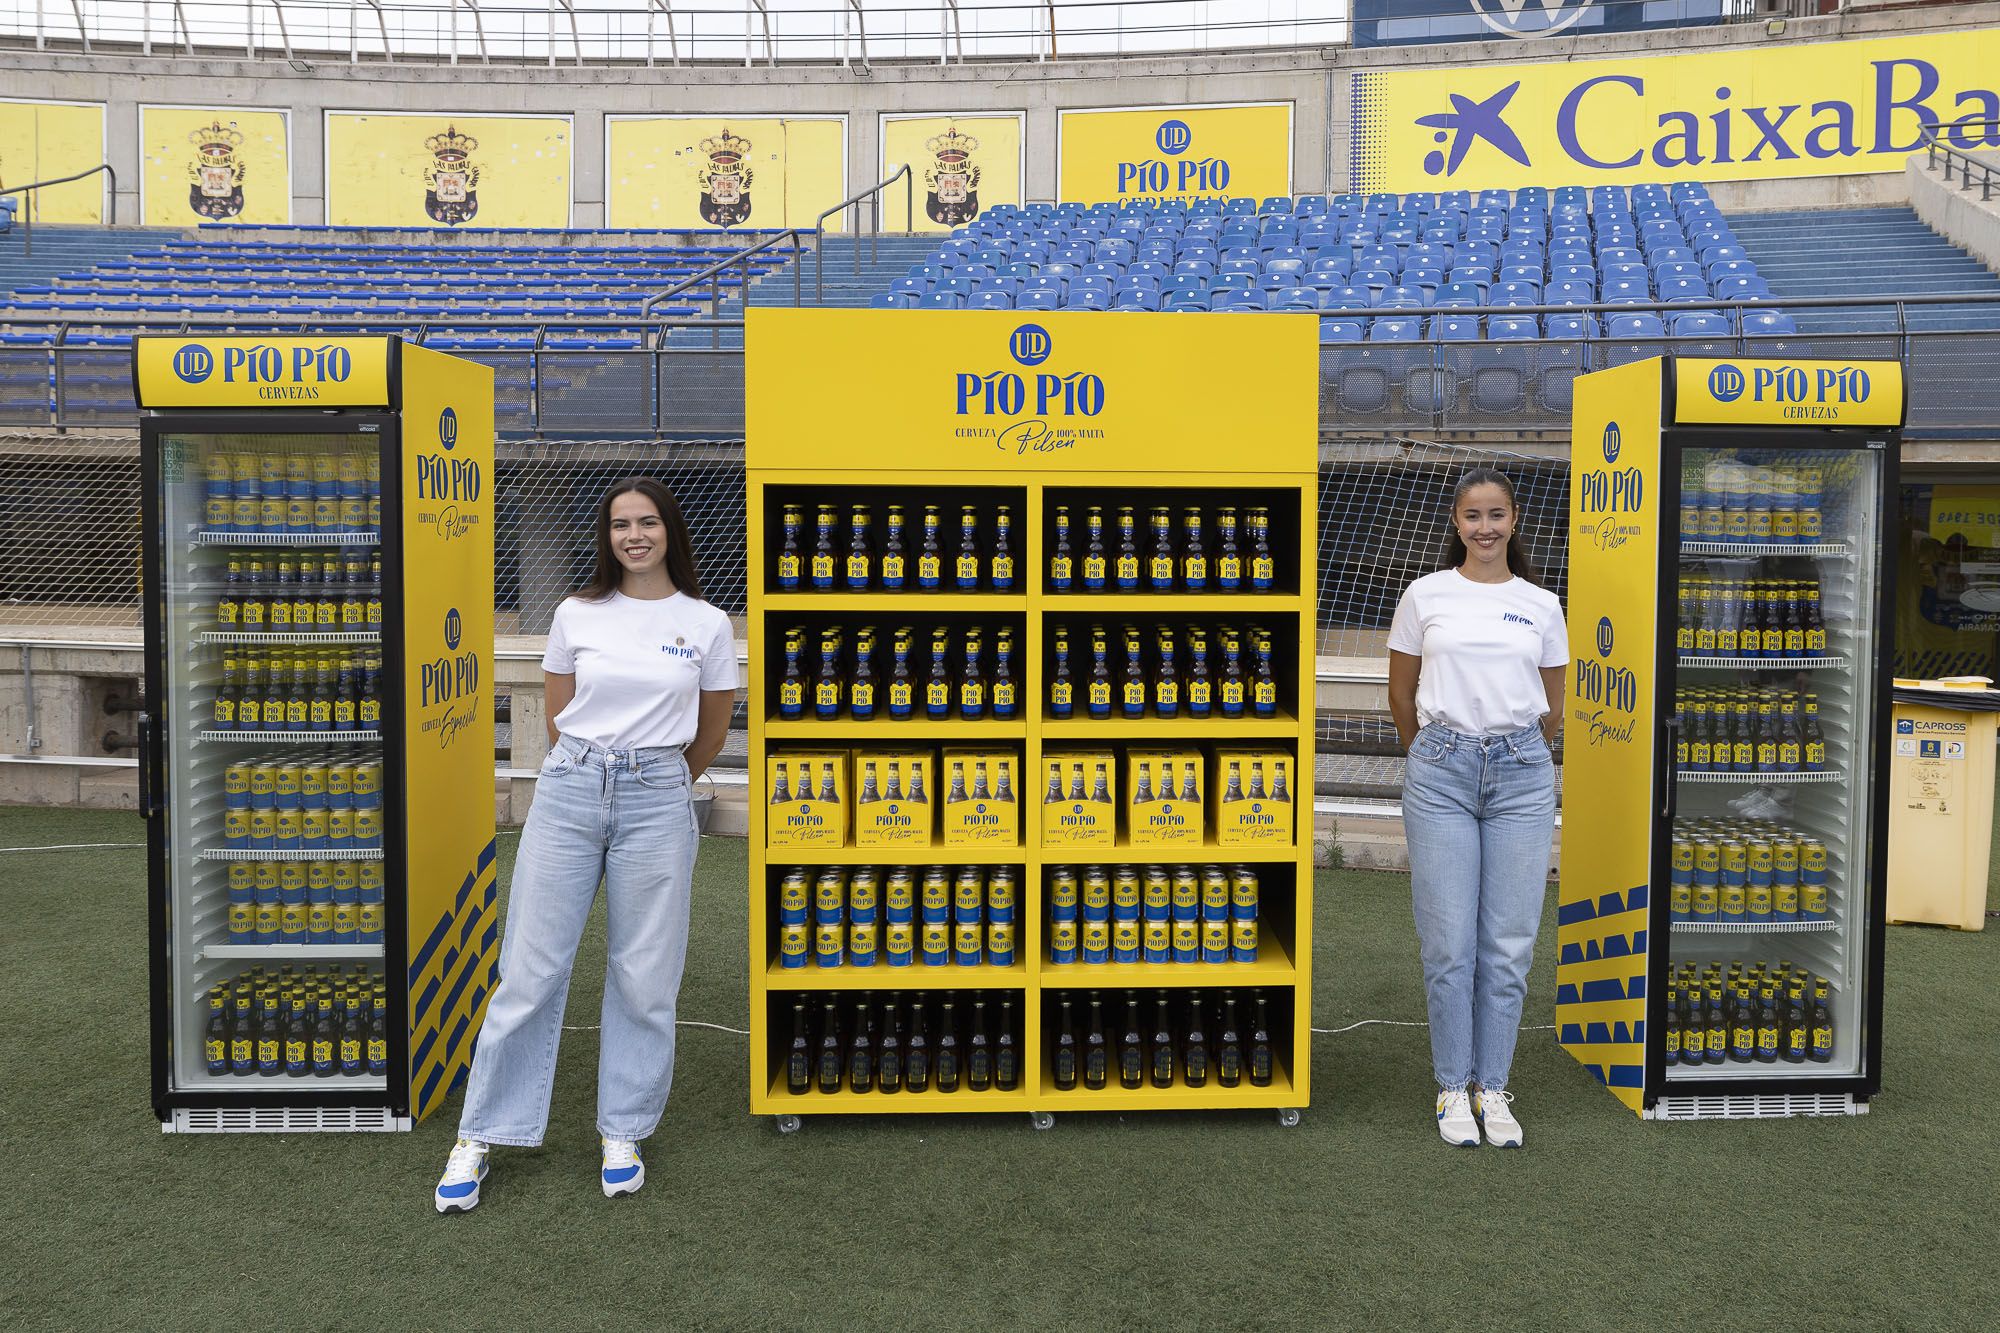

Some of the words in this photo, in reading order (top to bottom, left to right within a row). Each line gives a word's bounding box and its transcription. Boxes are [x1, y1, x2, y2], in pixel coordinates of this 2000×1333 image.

[259, 386, 319, 400] CERVEZAS
[1783, 406, 1839, 419] CERVEZAS
[955, 428, 996, 438] CERVEZA
[997, 419, 1075, 455] Pilsen
[1056, 429, 1077, 439] 100%
[1078, 429, 1105, 439] MALTA
[1915, 721, 1966, 731] CAPROSS
